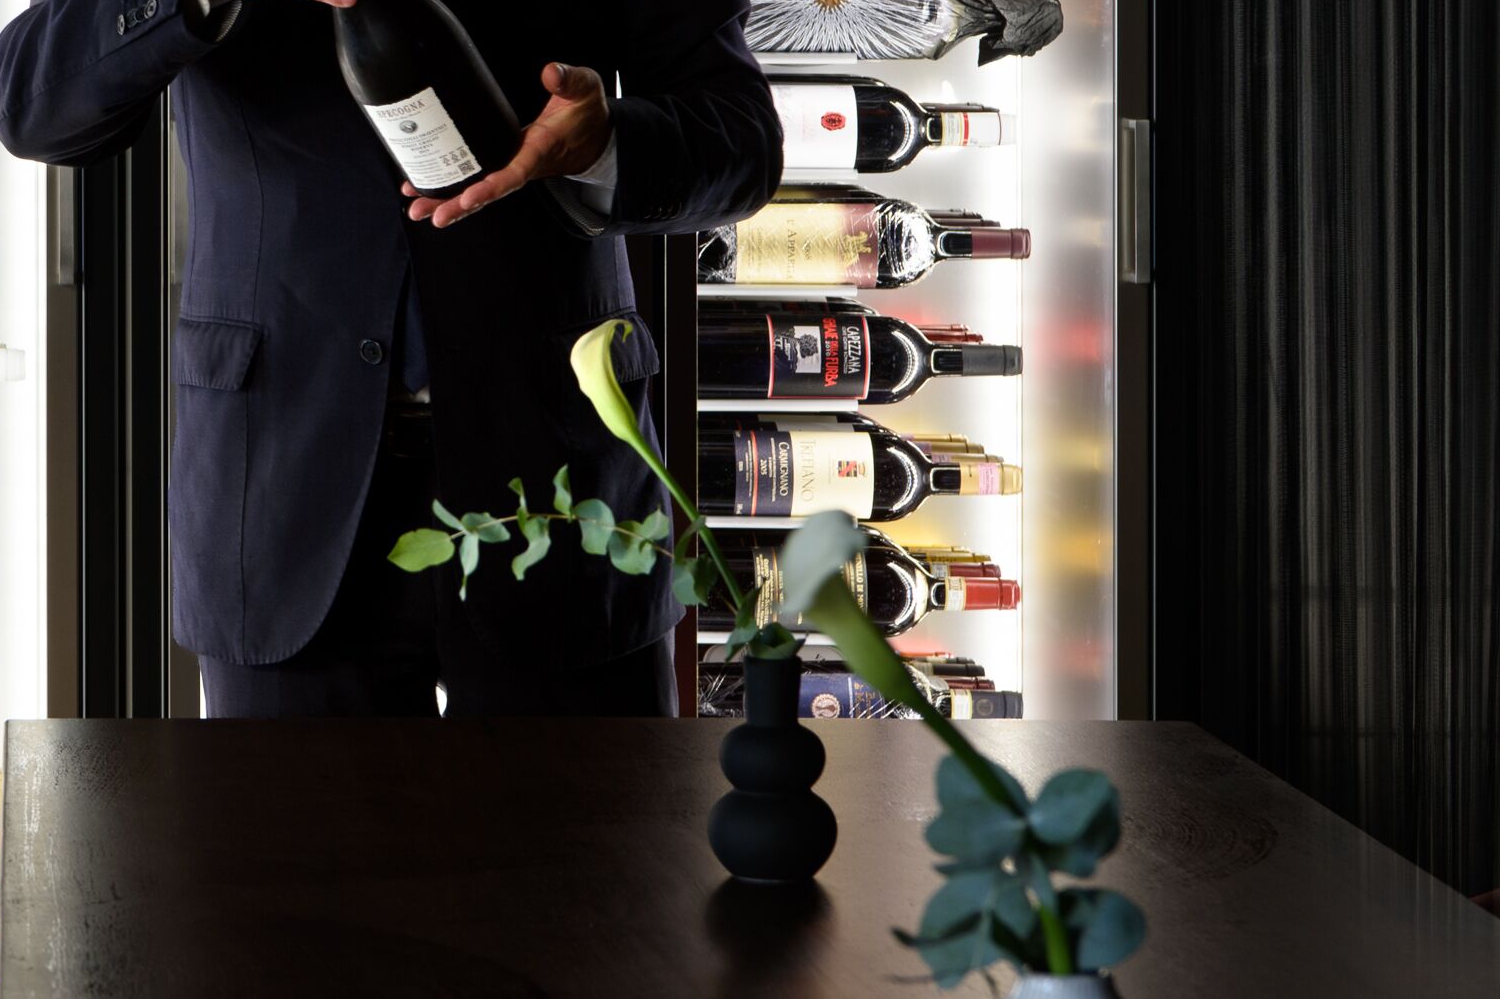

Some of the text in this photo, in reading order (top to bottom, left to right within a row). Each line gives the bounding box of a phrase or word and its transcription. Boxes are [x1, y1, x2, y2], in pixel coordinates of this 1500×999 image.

[824, 357, 839, 387] FURBA
[846, 326, 861, 374] CAPEZZANA
[779, 441, 791, 497] CARMIGNANO
[799, 441, 816, 502] TREFIANO
